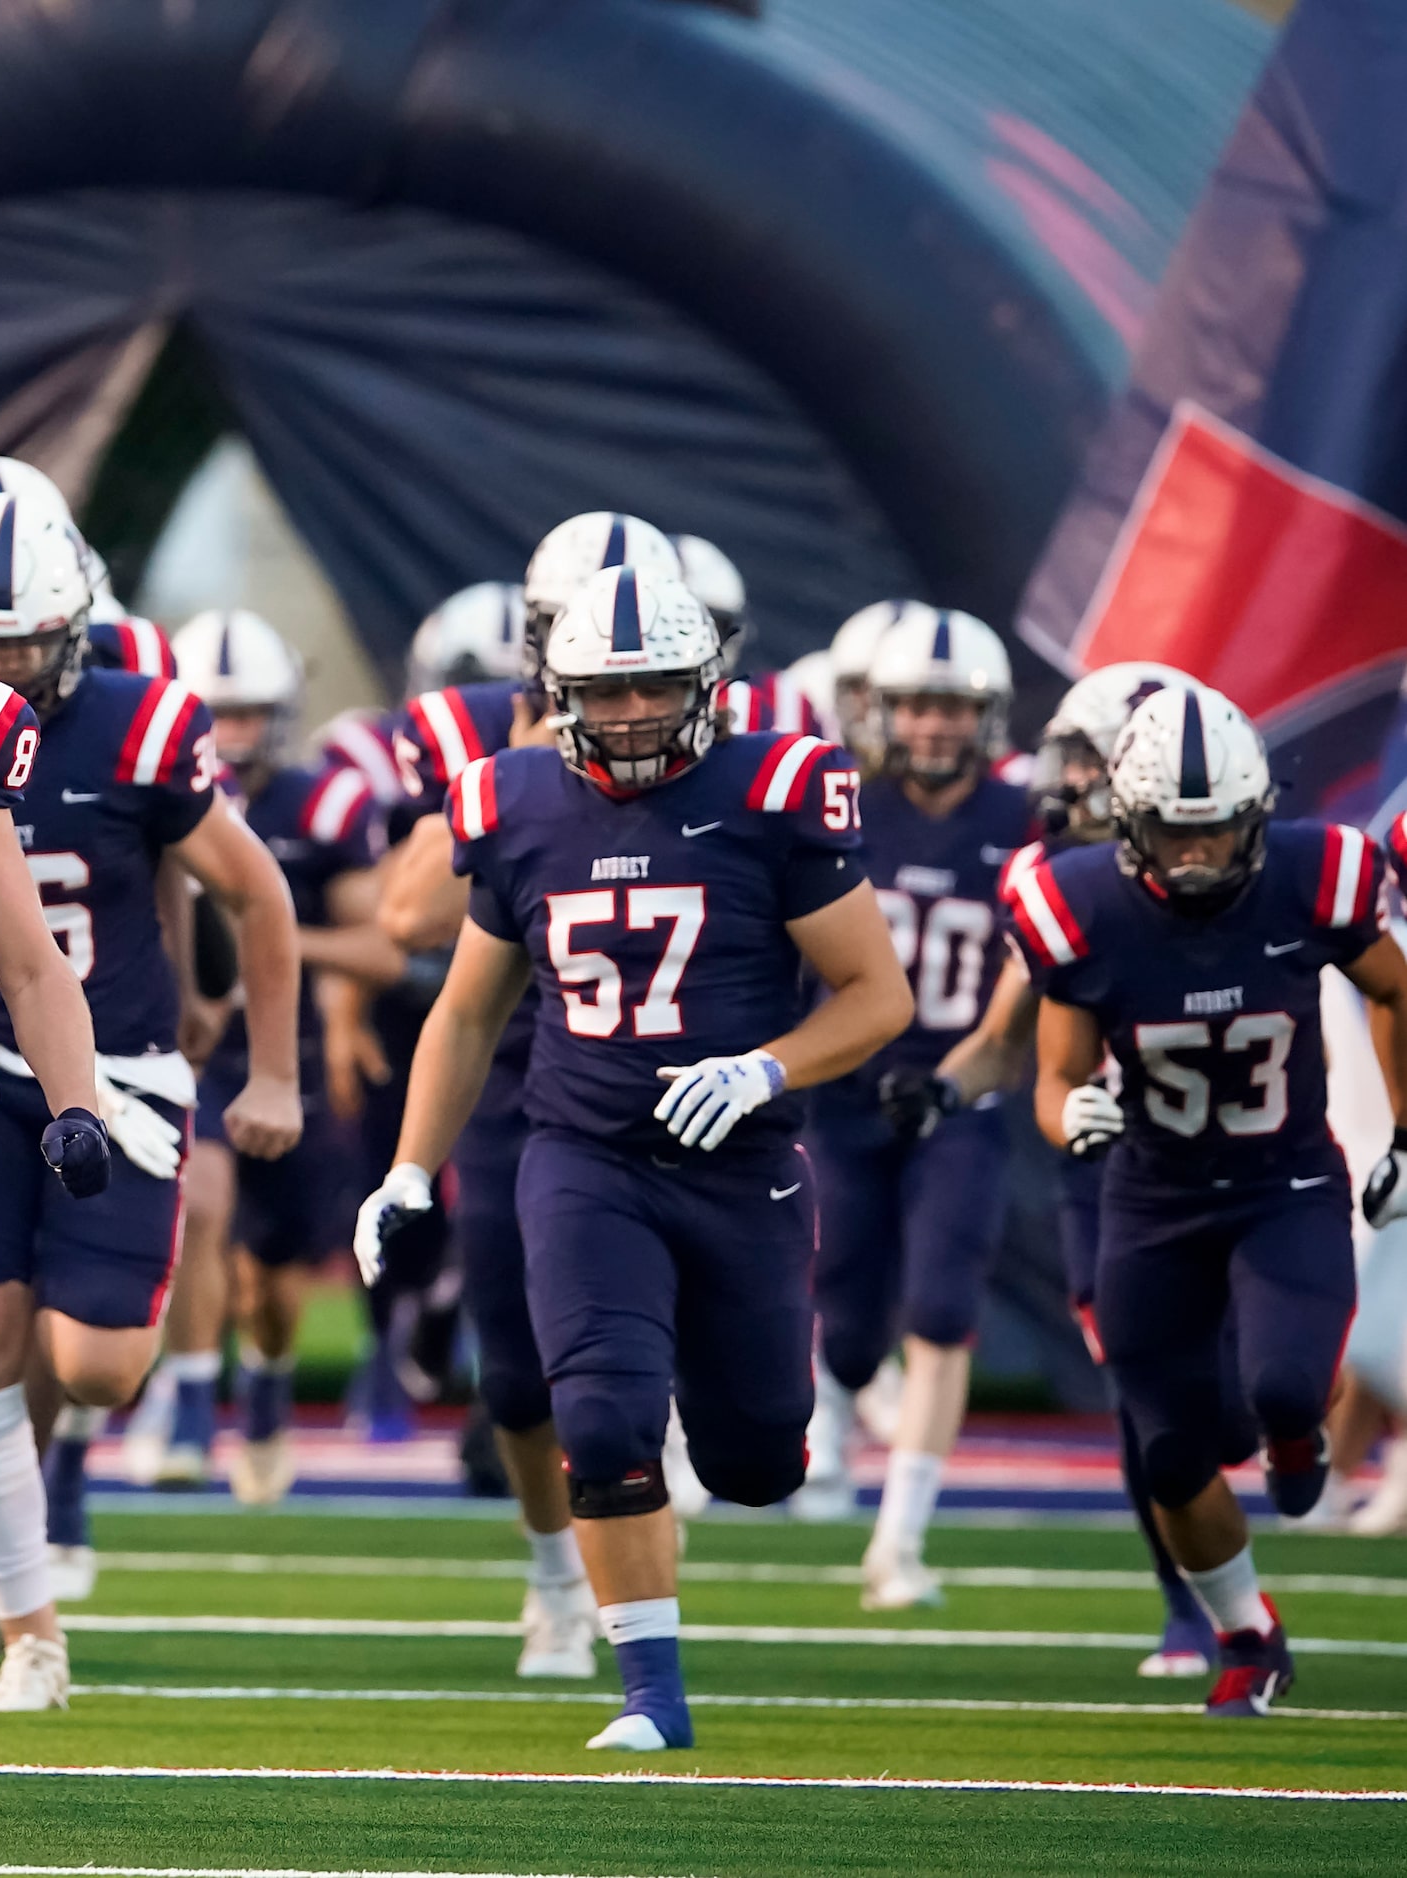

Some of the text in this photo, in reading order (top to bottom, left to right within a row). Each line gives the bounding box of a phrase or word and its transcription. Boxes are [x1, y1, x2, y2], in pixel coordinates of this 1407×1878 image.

[4, 727, 42, 790] 8
[545, 884, 706, 1038] 57
[1135, 1011, 1297, 1137] 53
